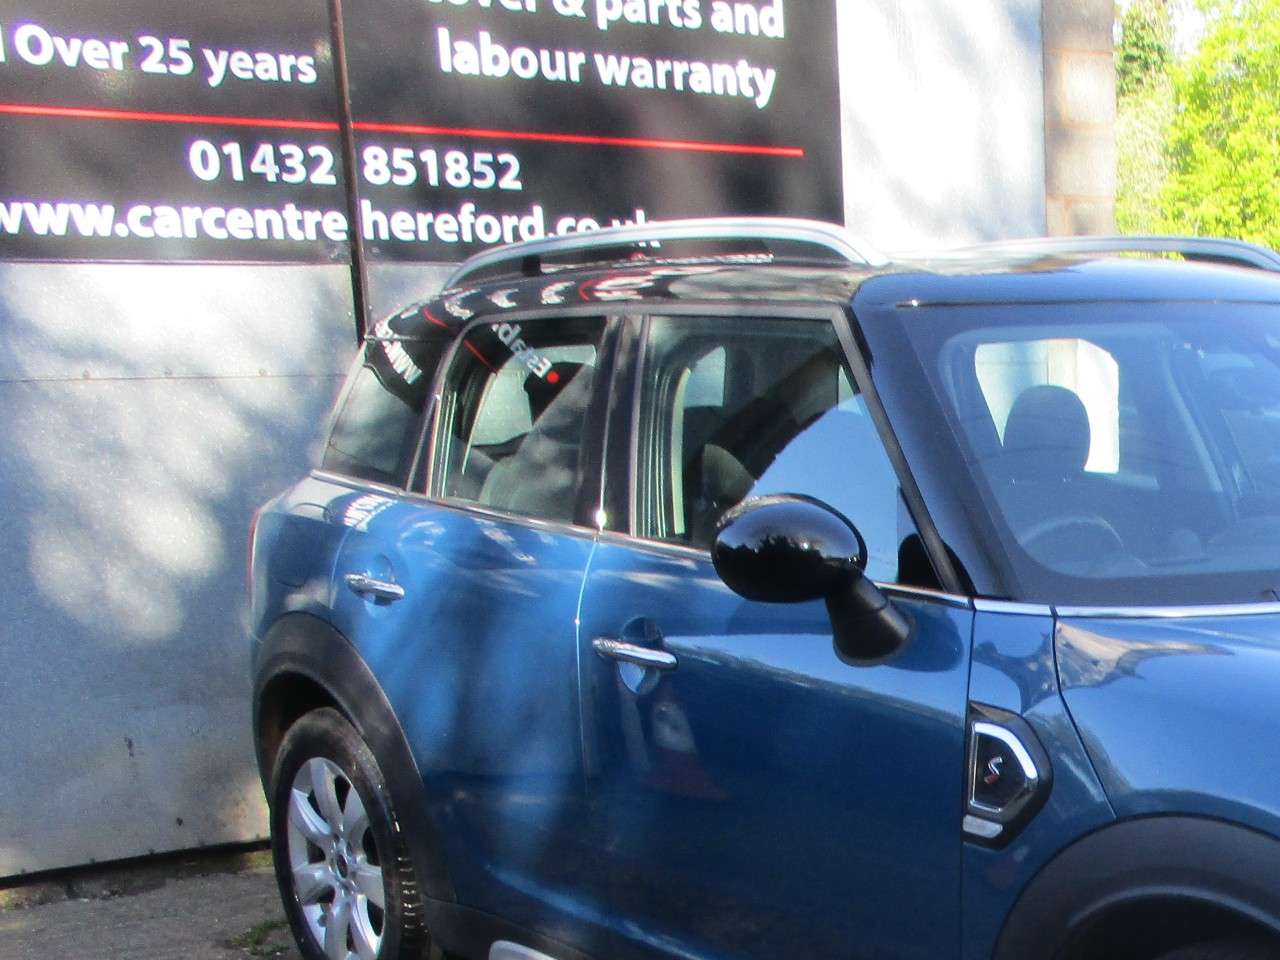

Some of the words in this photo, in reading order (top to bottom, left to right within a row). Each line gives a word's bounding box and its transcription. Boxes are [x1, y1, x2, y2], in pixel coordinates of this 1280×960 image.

[594, 0, 704, 31] parts
[709, 0, 786, 39] and
[13, 23, 130, 75] Over
[137, 35, 194, 75] 25
[202, 48, 317, 87] years
[436, 26, 586, 82] labour
[593, 52, 777, 109] warranty
[188, 139, 337, 185] 01432
[362, 145, 522, 191] 851852
